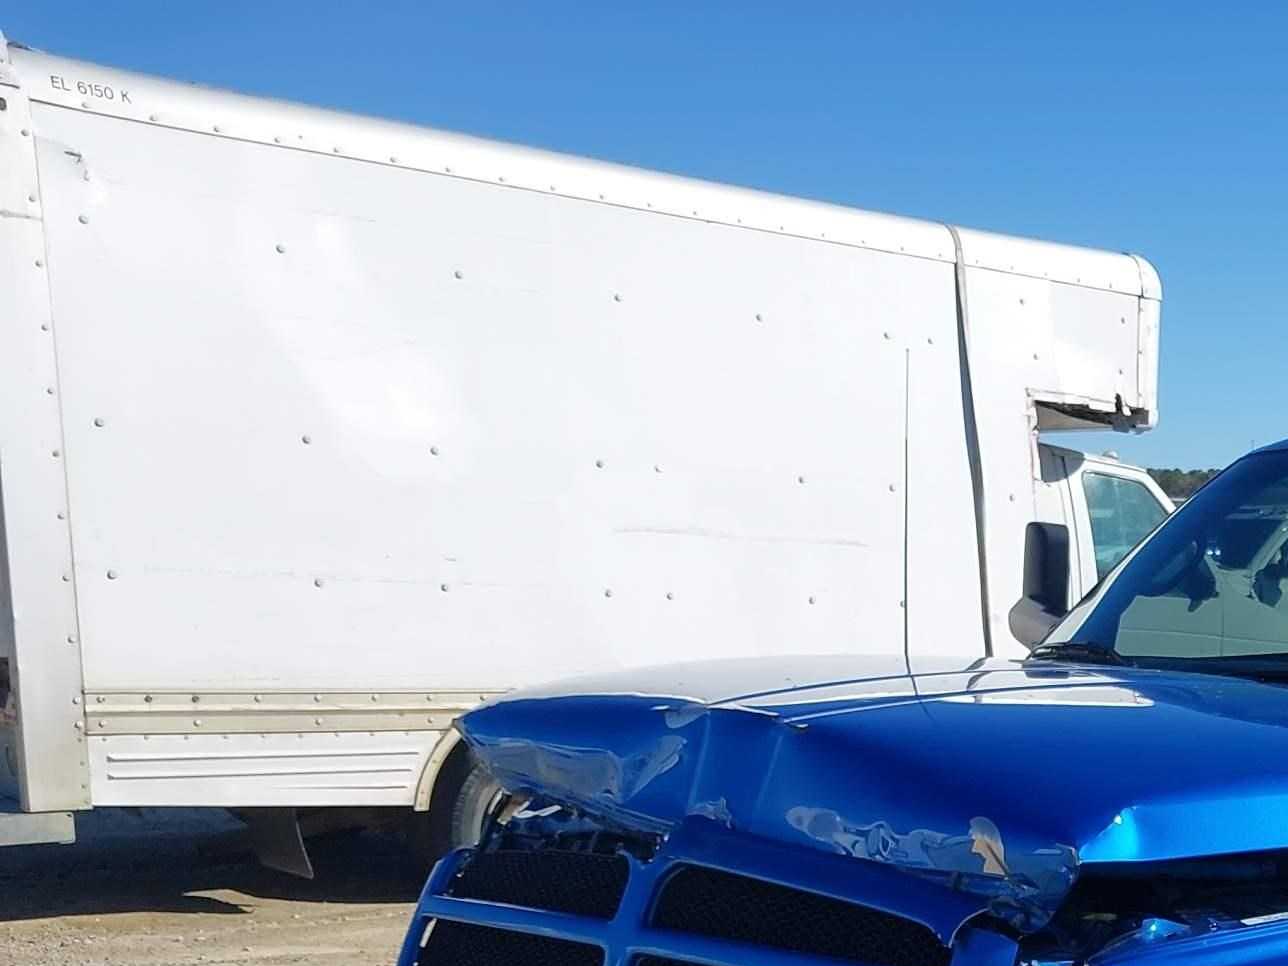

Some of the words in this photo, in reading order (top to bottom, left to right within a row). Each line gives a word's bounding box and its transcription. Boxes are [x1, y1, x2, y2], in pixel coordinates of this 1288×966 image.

[50, 75, 72, 92] EL
[76, 81, 114, 100] 6150
[120, 90, 132, 104] K
